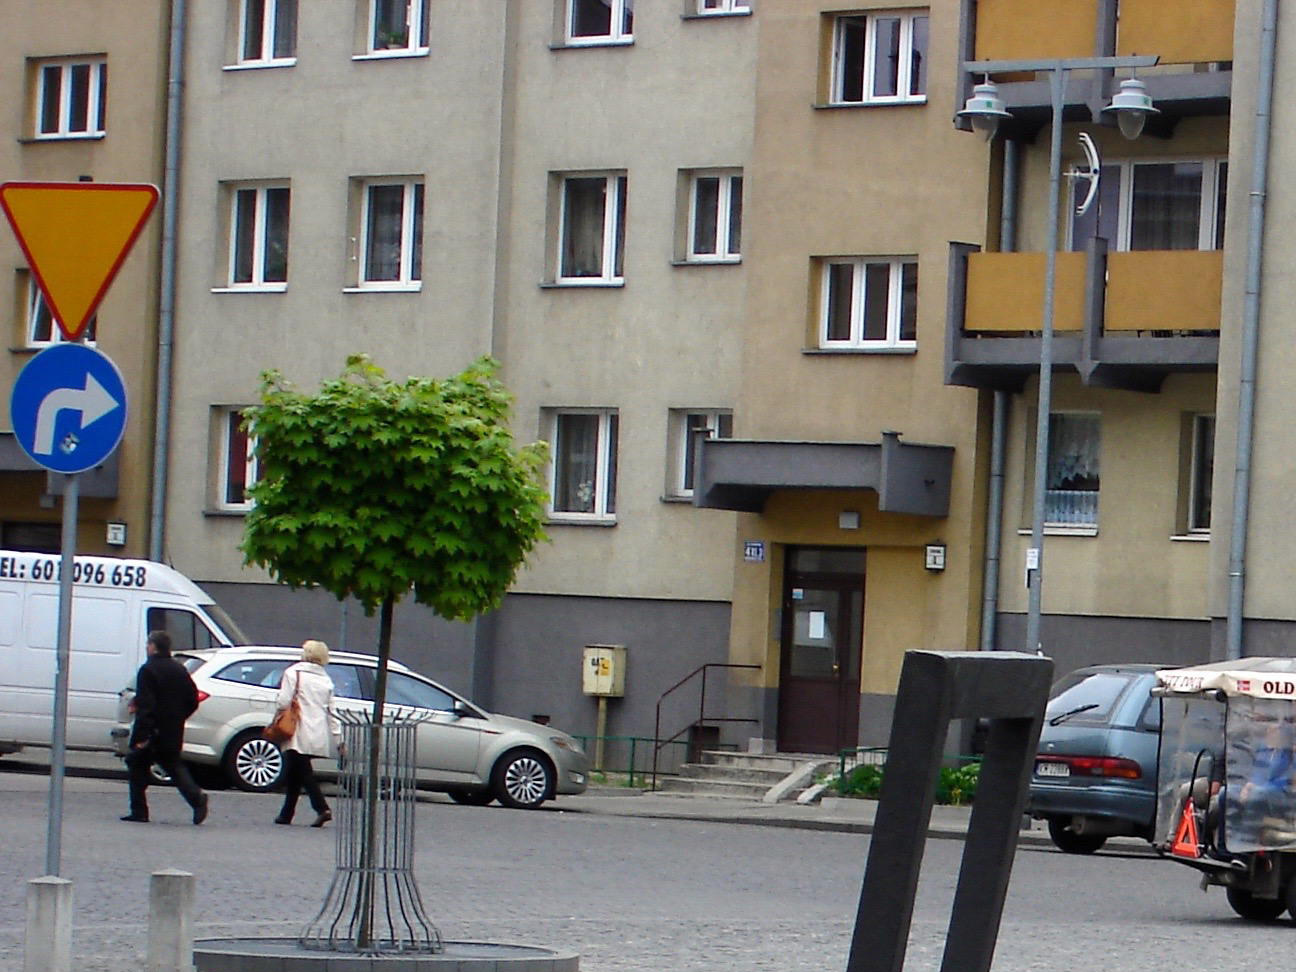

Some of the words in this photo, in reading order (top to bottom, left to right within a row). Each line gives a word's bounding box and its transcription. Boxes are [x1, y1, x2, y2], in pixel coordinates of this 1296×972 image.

[73, 562, 105, 584] 096
[111, 564, 147, 587] 658
[1263, 680, 1295, 695] OLD
